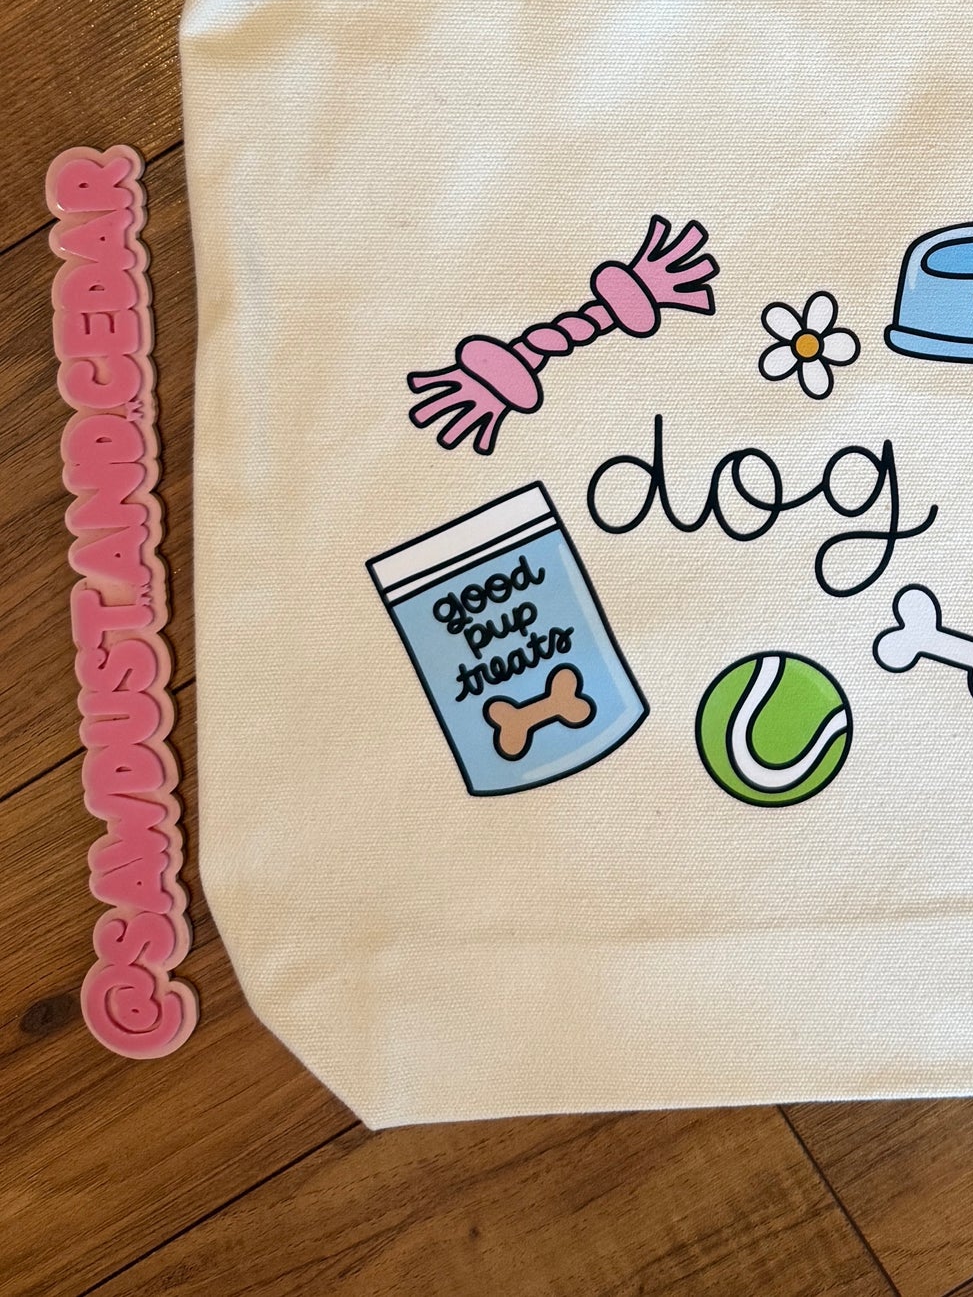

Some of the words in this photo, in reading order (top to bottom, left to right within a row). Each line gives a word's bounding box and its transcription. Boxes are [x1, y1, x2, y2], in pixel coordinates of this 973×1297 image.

[586, 413, 939, 598] dog
[52, 156, 184, 1054] @SAWDUSTANDCEDAR
[433, 555, 546, 634] good
[463, 601, 539, 660] pup
[454, 625, 576, 703] treats
